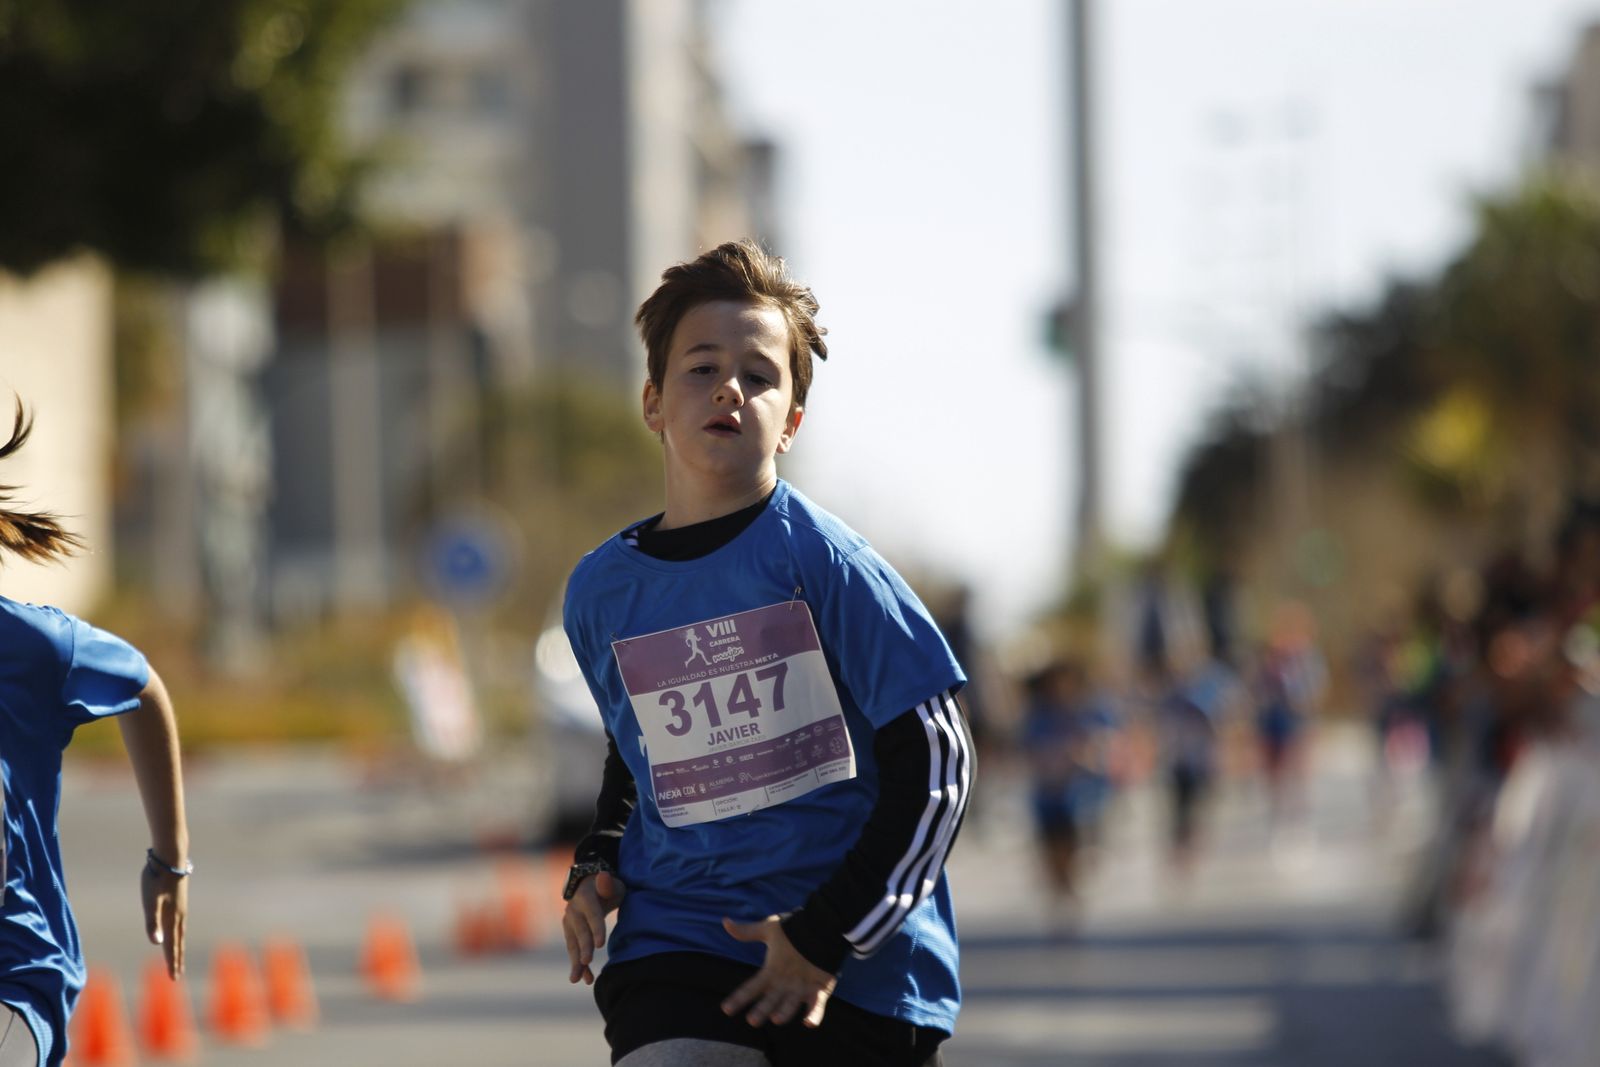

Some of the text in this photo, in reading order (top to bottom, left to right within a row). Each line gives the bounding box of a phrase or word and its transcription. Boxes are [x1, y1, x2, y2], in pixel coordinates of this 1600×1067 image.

[706, 619, 736, 638] VIII
[668, 671, 706, 685] IGUALDAD
[719, 660, 755, 673] NUESTRA
[755, 653, 779, 664] META
[659, 662, 789, 737] 3147
[707, 722, 761, 746] JAVIER
[658, 789, 682, 801] NEXA
